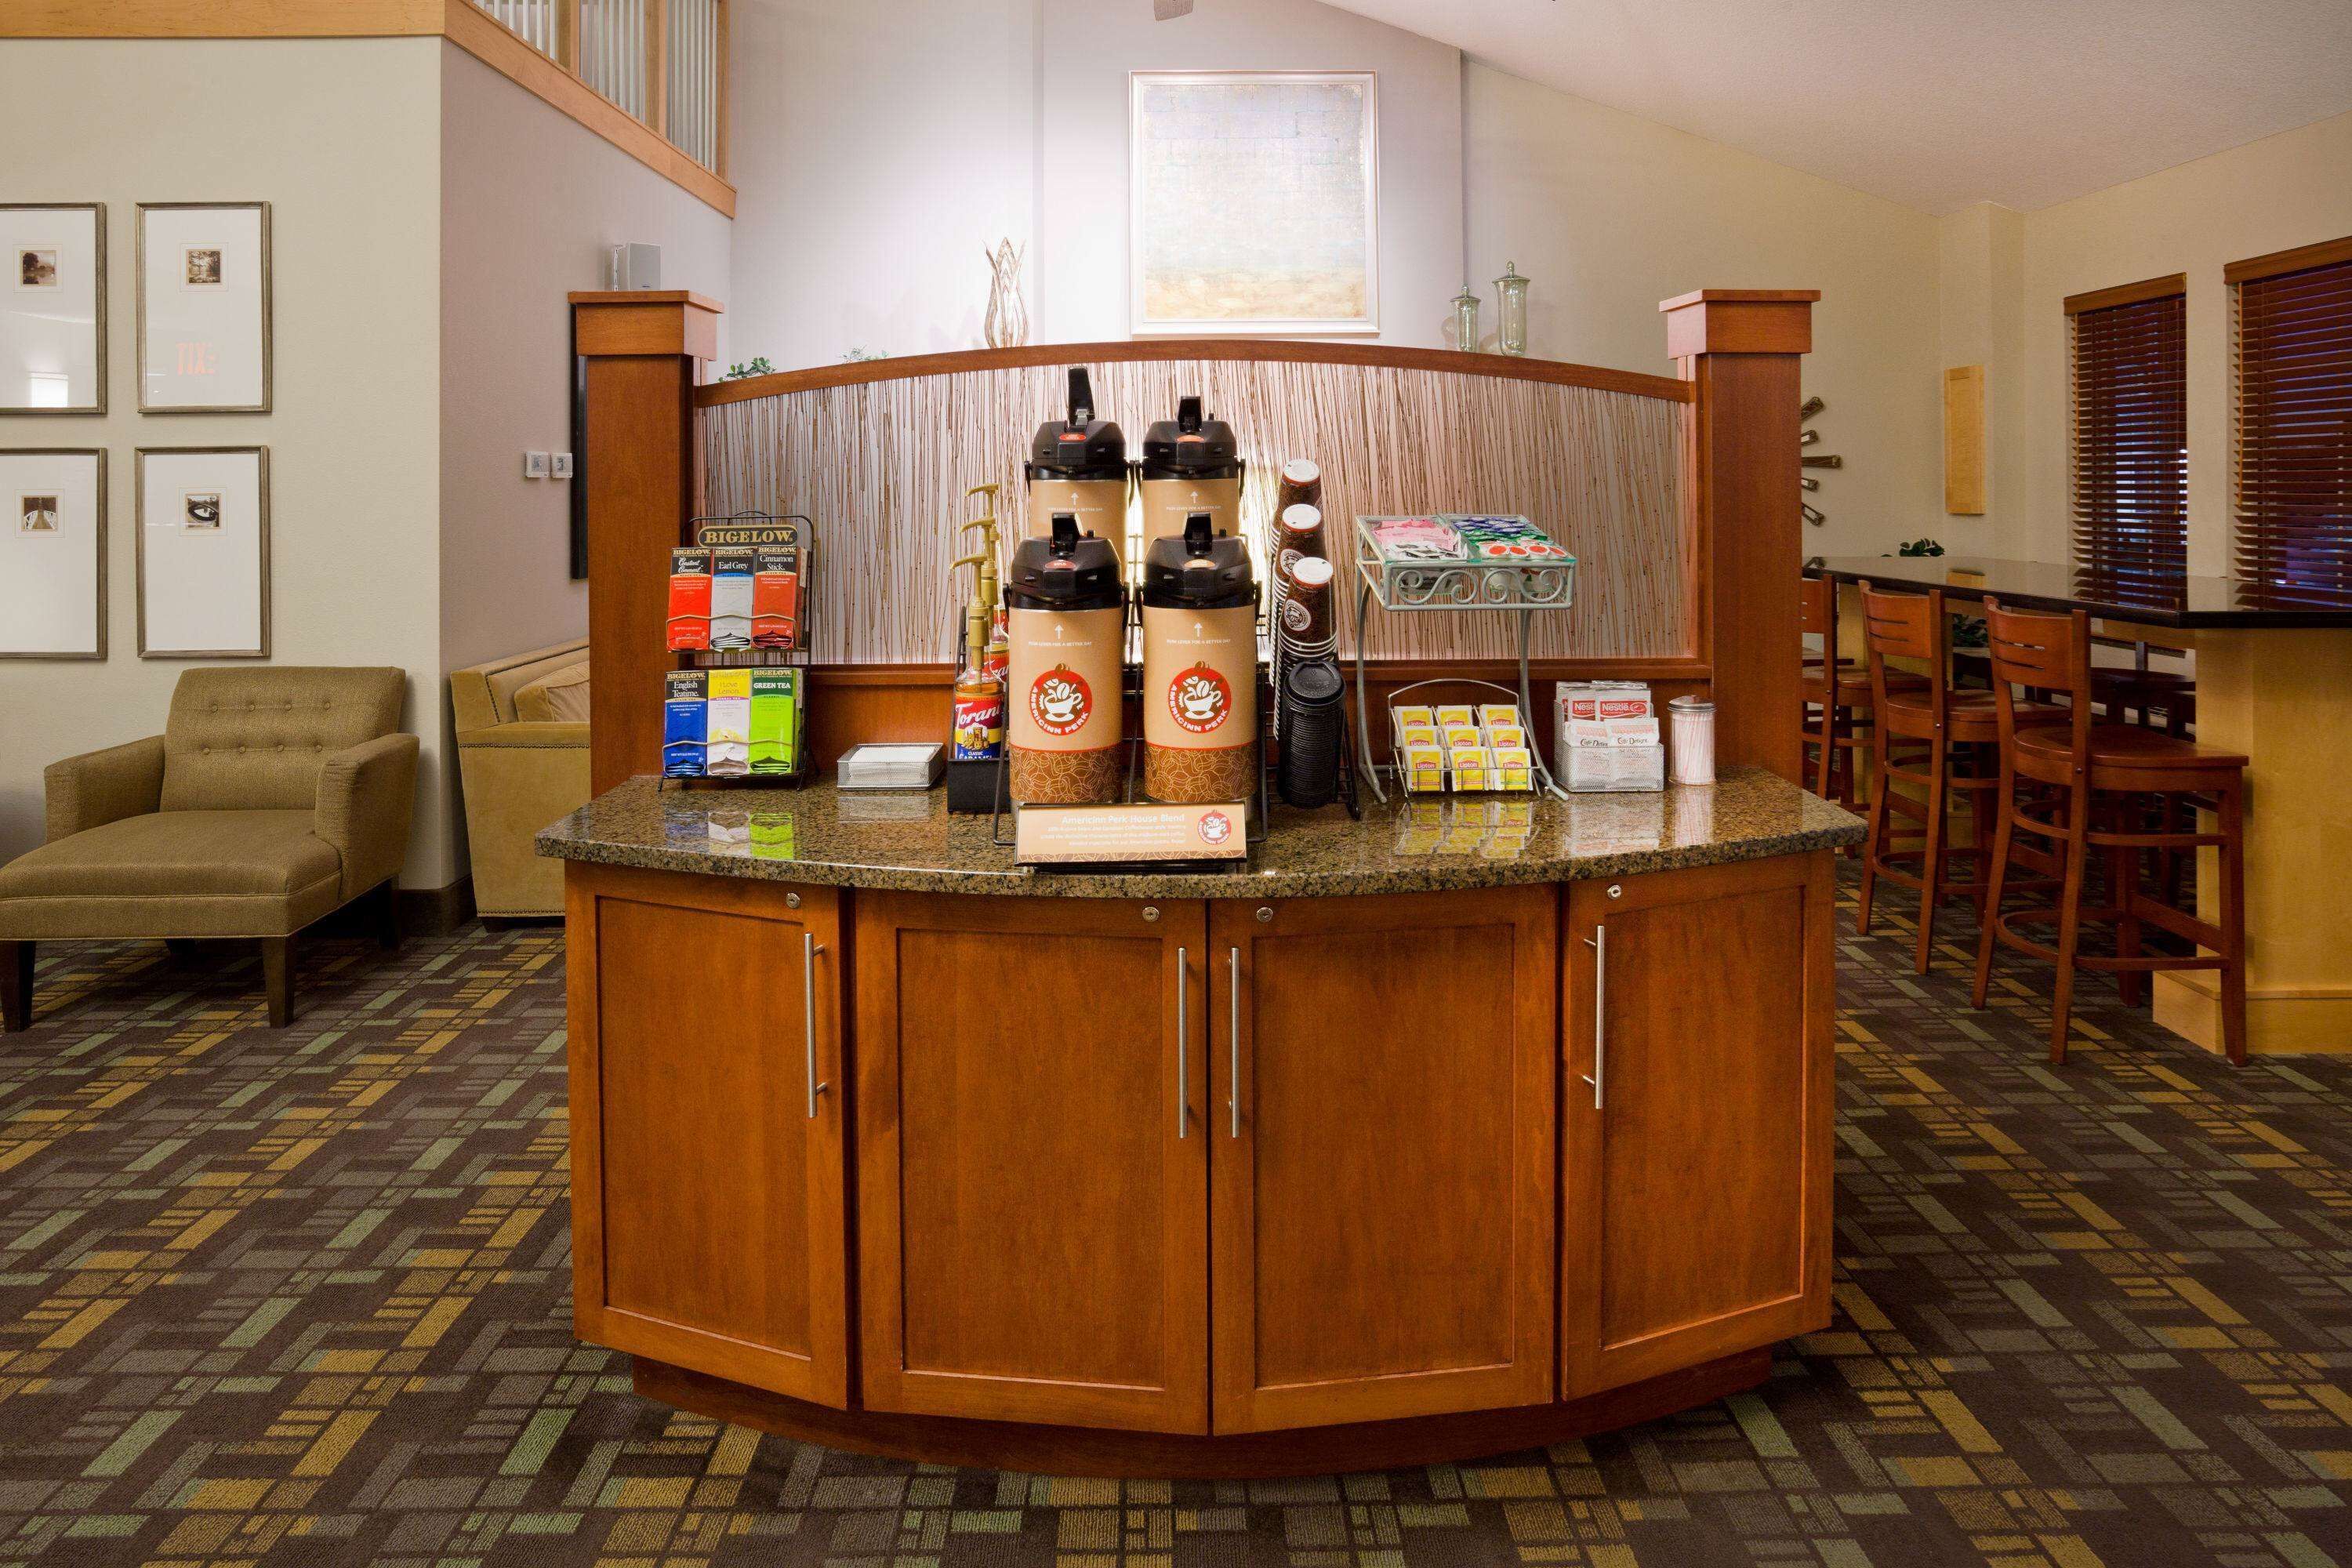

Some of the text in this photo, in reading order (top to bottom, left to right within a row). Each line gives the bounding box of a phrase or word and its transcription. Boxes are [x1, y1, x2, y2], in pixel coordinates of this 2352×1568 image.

[704, 530, 793, 543] BIGELOW
[760, 554, 793, 563] Cinnamon
[732, 561, 749, 571] Grey
[673, 681, 698, 691] English
[1169, 684, 1228, 731] AMERICINN PERK
[1065, 712, 1089, 733] PERK
[1160, 814, 1185, 822] Blend
